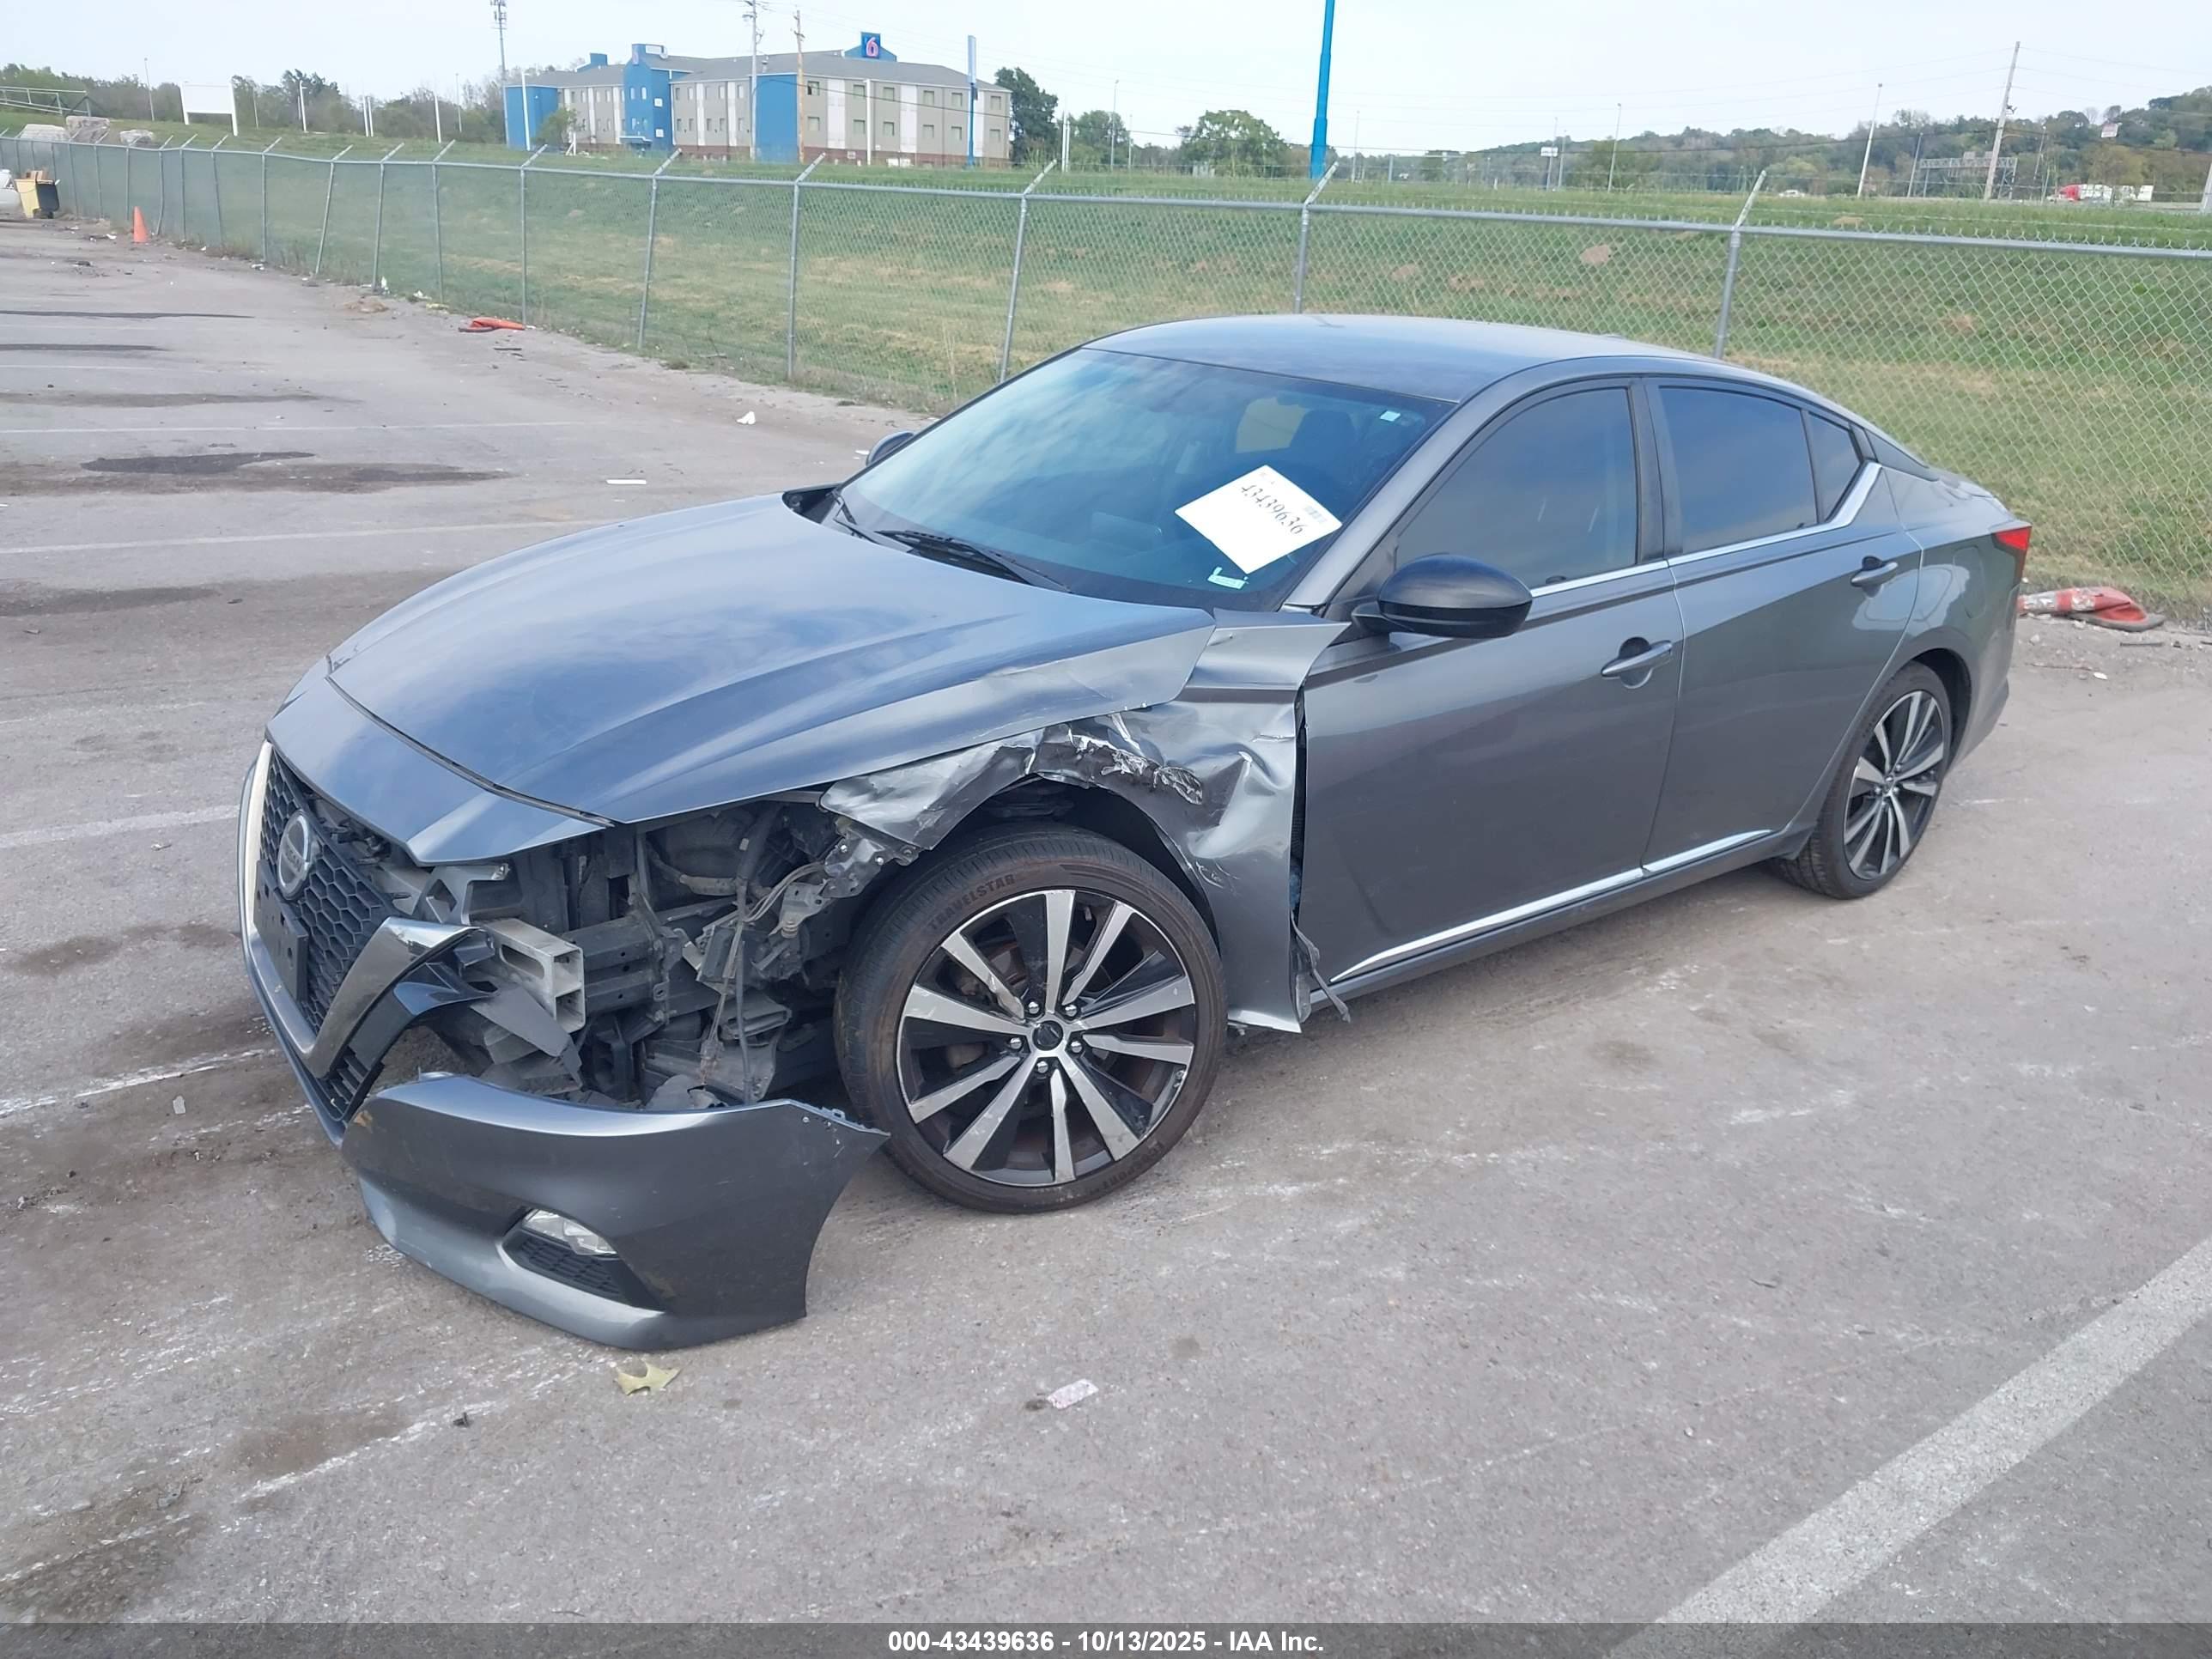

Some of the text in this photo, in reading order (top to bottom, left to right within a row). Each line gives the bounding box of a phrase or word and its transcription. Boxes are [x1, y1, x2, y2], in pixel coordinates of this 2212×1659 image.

[866, 36, 879, 57] 6
[1241, 484, 1304, 535] 43439636
[928, 872, 1017, 931] TRAVELSTAR
